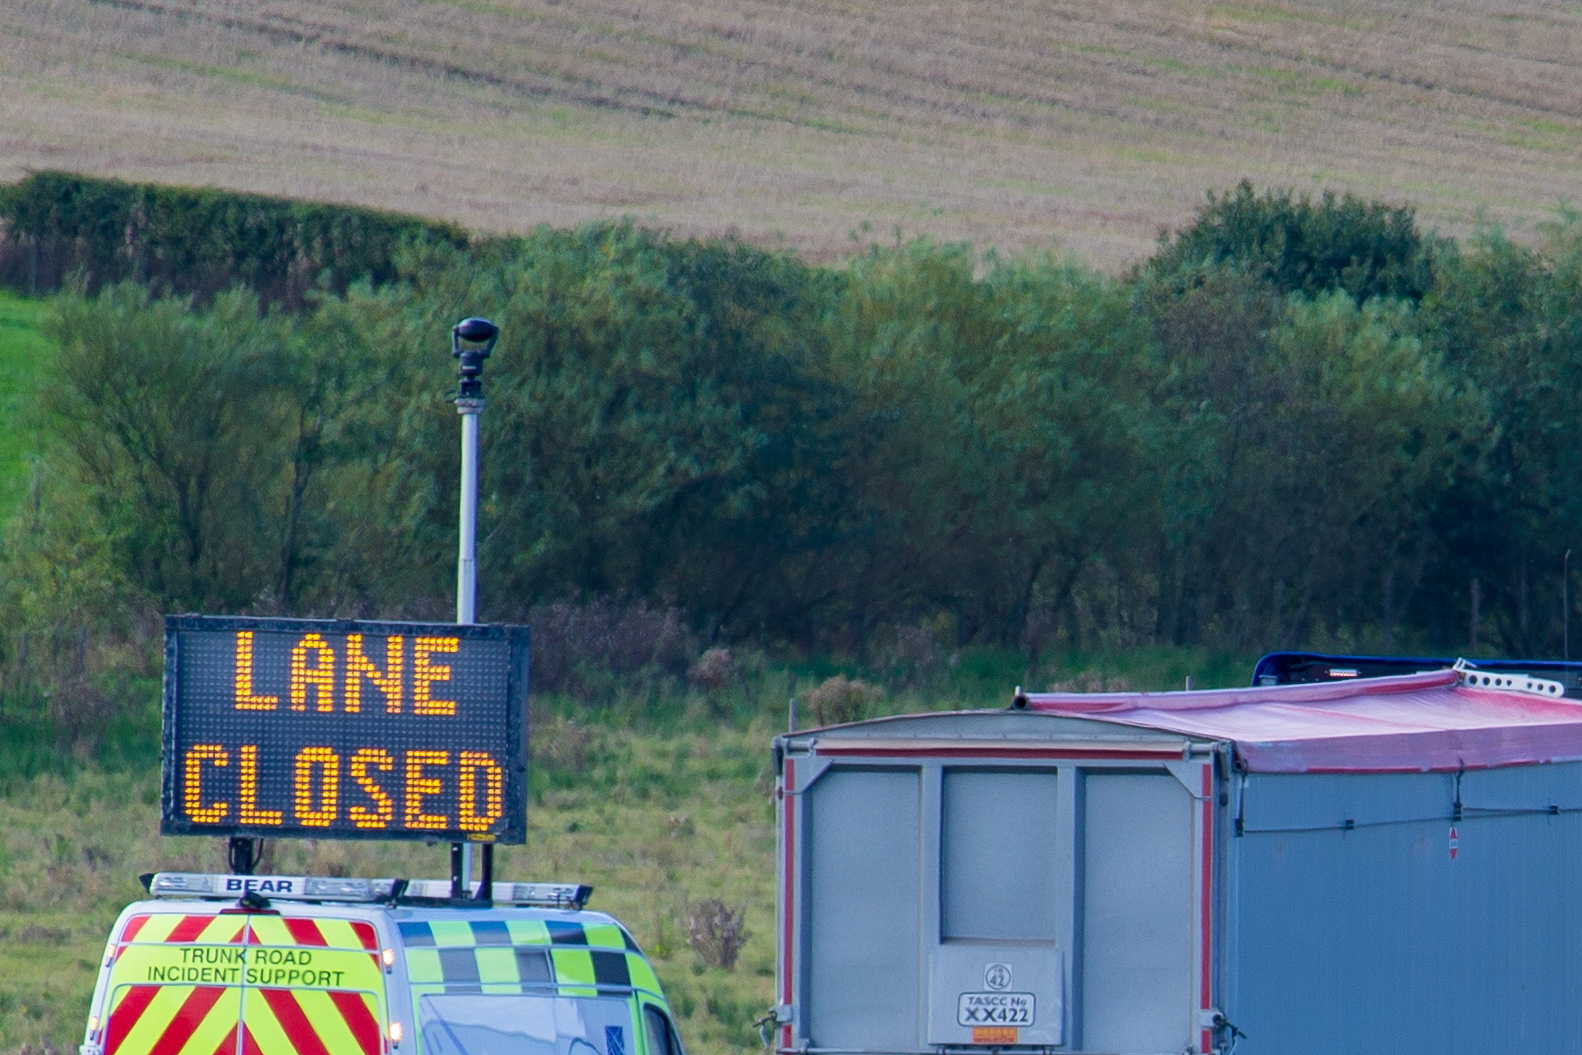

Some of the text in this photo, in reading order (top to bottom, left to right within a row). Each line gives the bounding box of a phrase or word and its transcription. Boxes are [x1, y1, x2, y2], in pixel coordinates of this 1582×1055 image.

[234, 630, 459, 715] LANE
[184, 745, 502, 831] CLOSED
[226, 878, 293, 893] BEAR
[179, 947, 313, 966] TRUNK ROAD
[147, 966, 345, 987] INCIDENT SUPPORT
[968, 997, 1007, 1006] TASCC
[965, 1007, 1028, 1023] XX422
